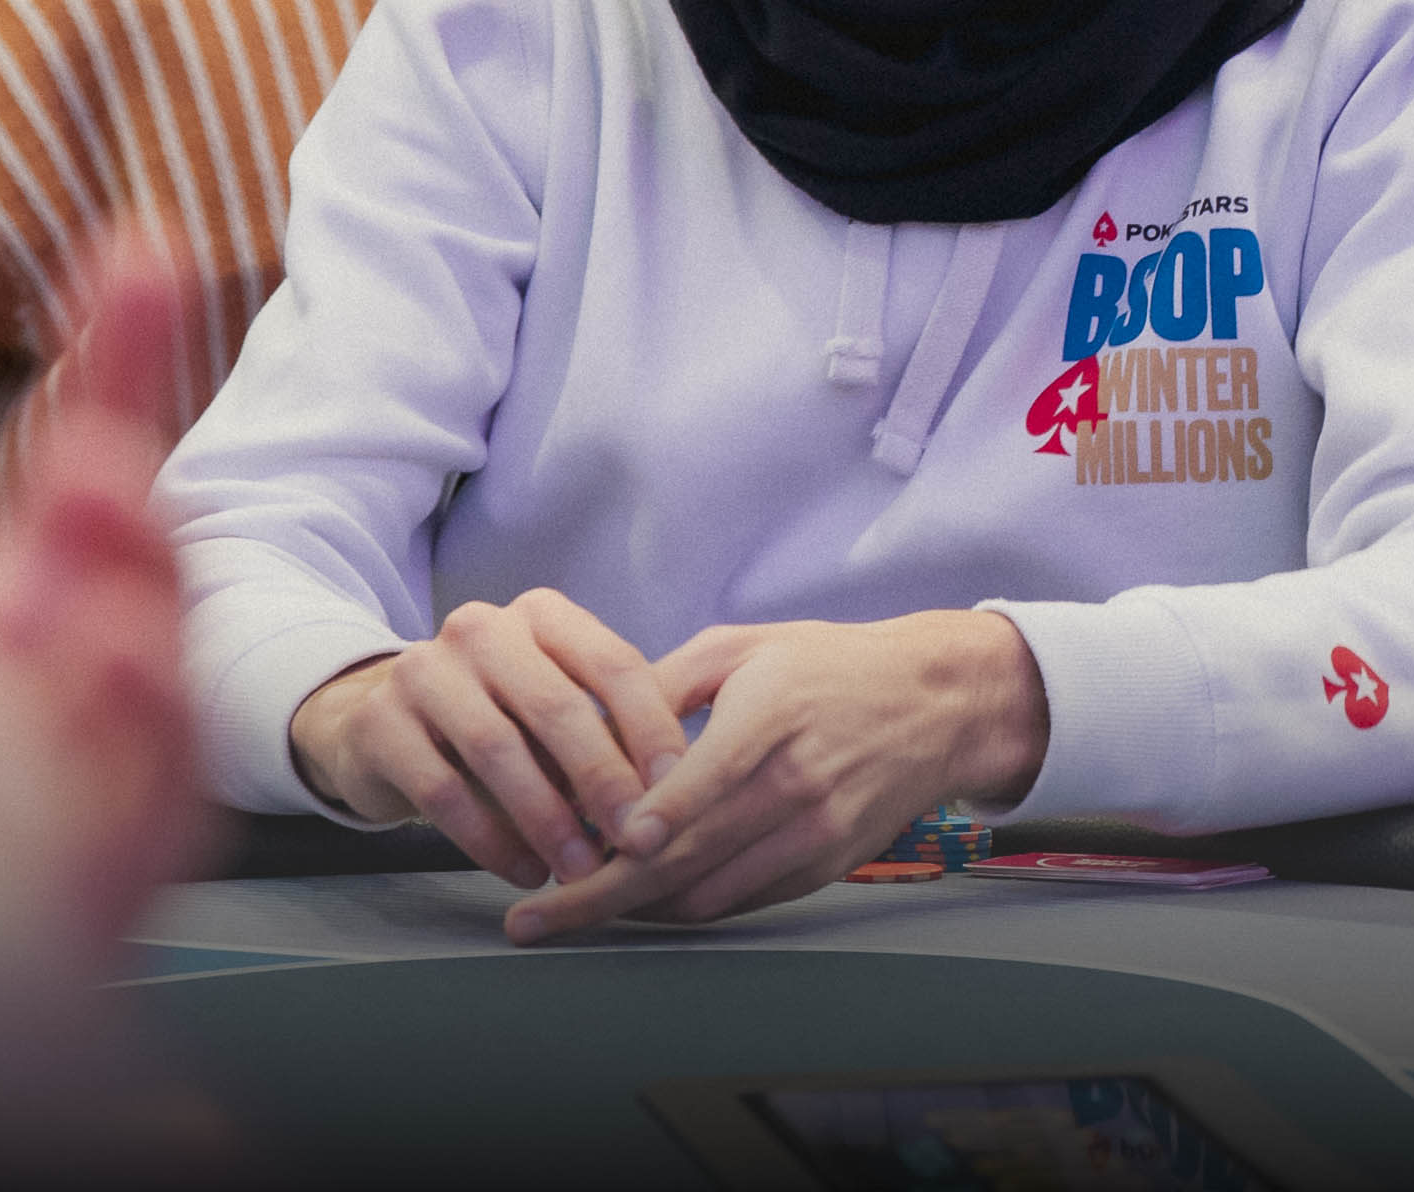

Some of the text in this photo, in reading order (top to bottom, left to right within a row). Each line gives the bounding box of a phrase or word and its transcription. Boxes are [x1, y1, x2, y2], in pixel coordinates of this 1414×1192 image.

[1062, 227, 1265, 362] BSOP
[1096, 346, 1260, 413] WINTER
[1075, 417, 1274, 486] MILLIONS
